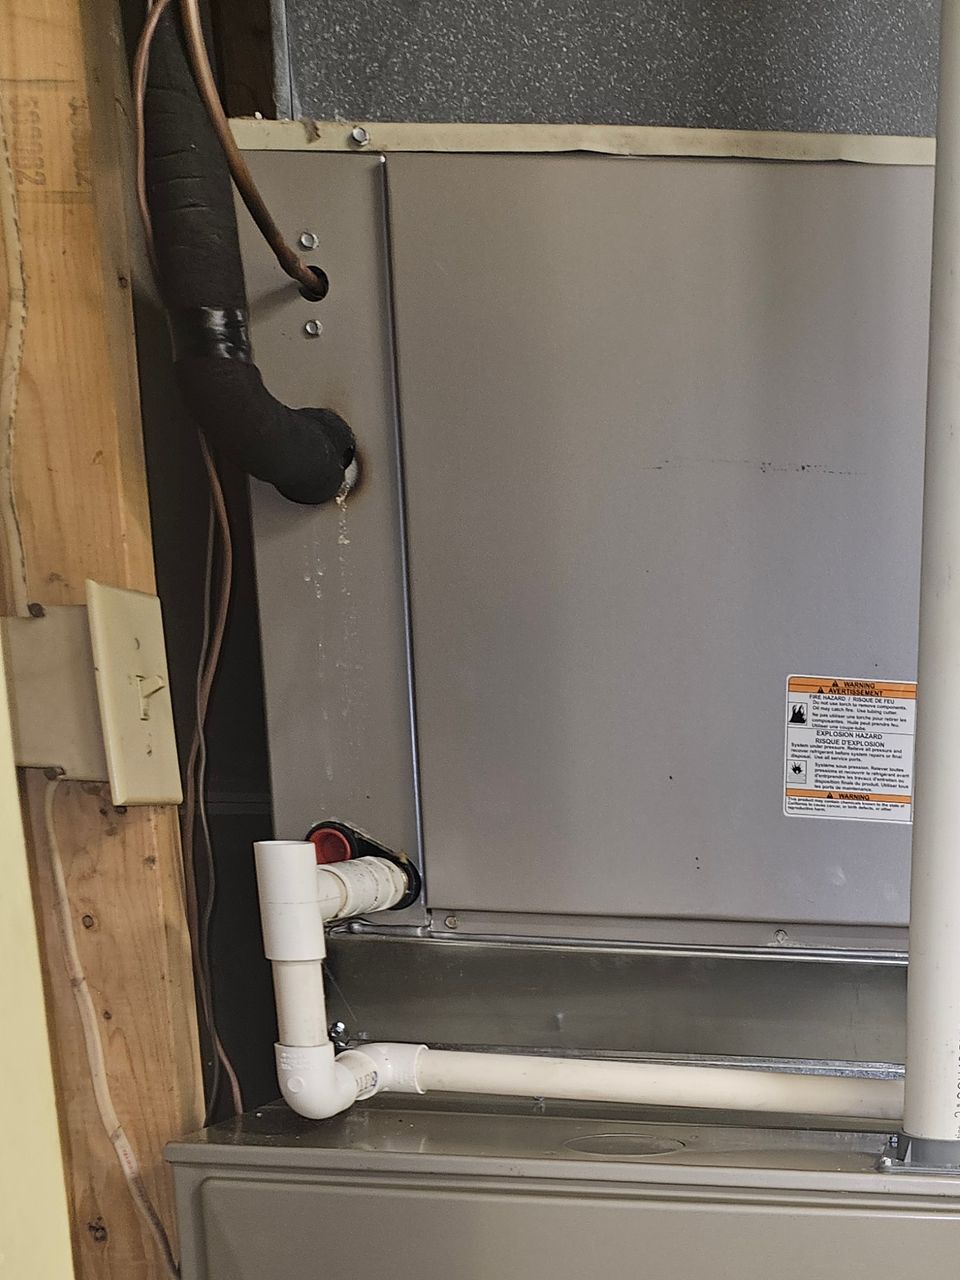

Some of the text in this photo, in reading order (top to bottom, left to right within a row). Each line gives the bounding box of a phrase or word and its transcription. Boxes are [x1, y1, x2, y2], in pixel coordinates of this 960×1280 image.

[828, 688, 882, 696] AVERTISSEMENT
[816, 729, 853, 737] EXPLOSION
[841, 739, 884, 747] D'EXPLOSION
